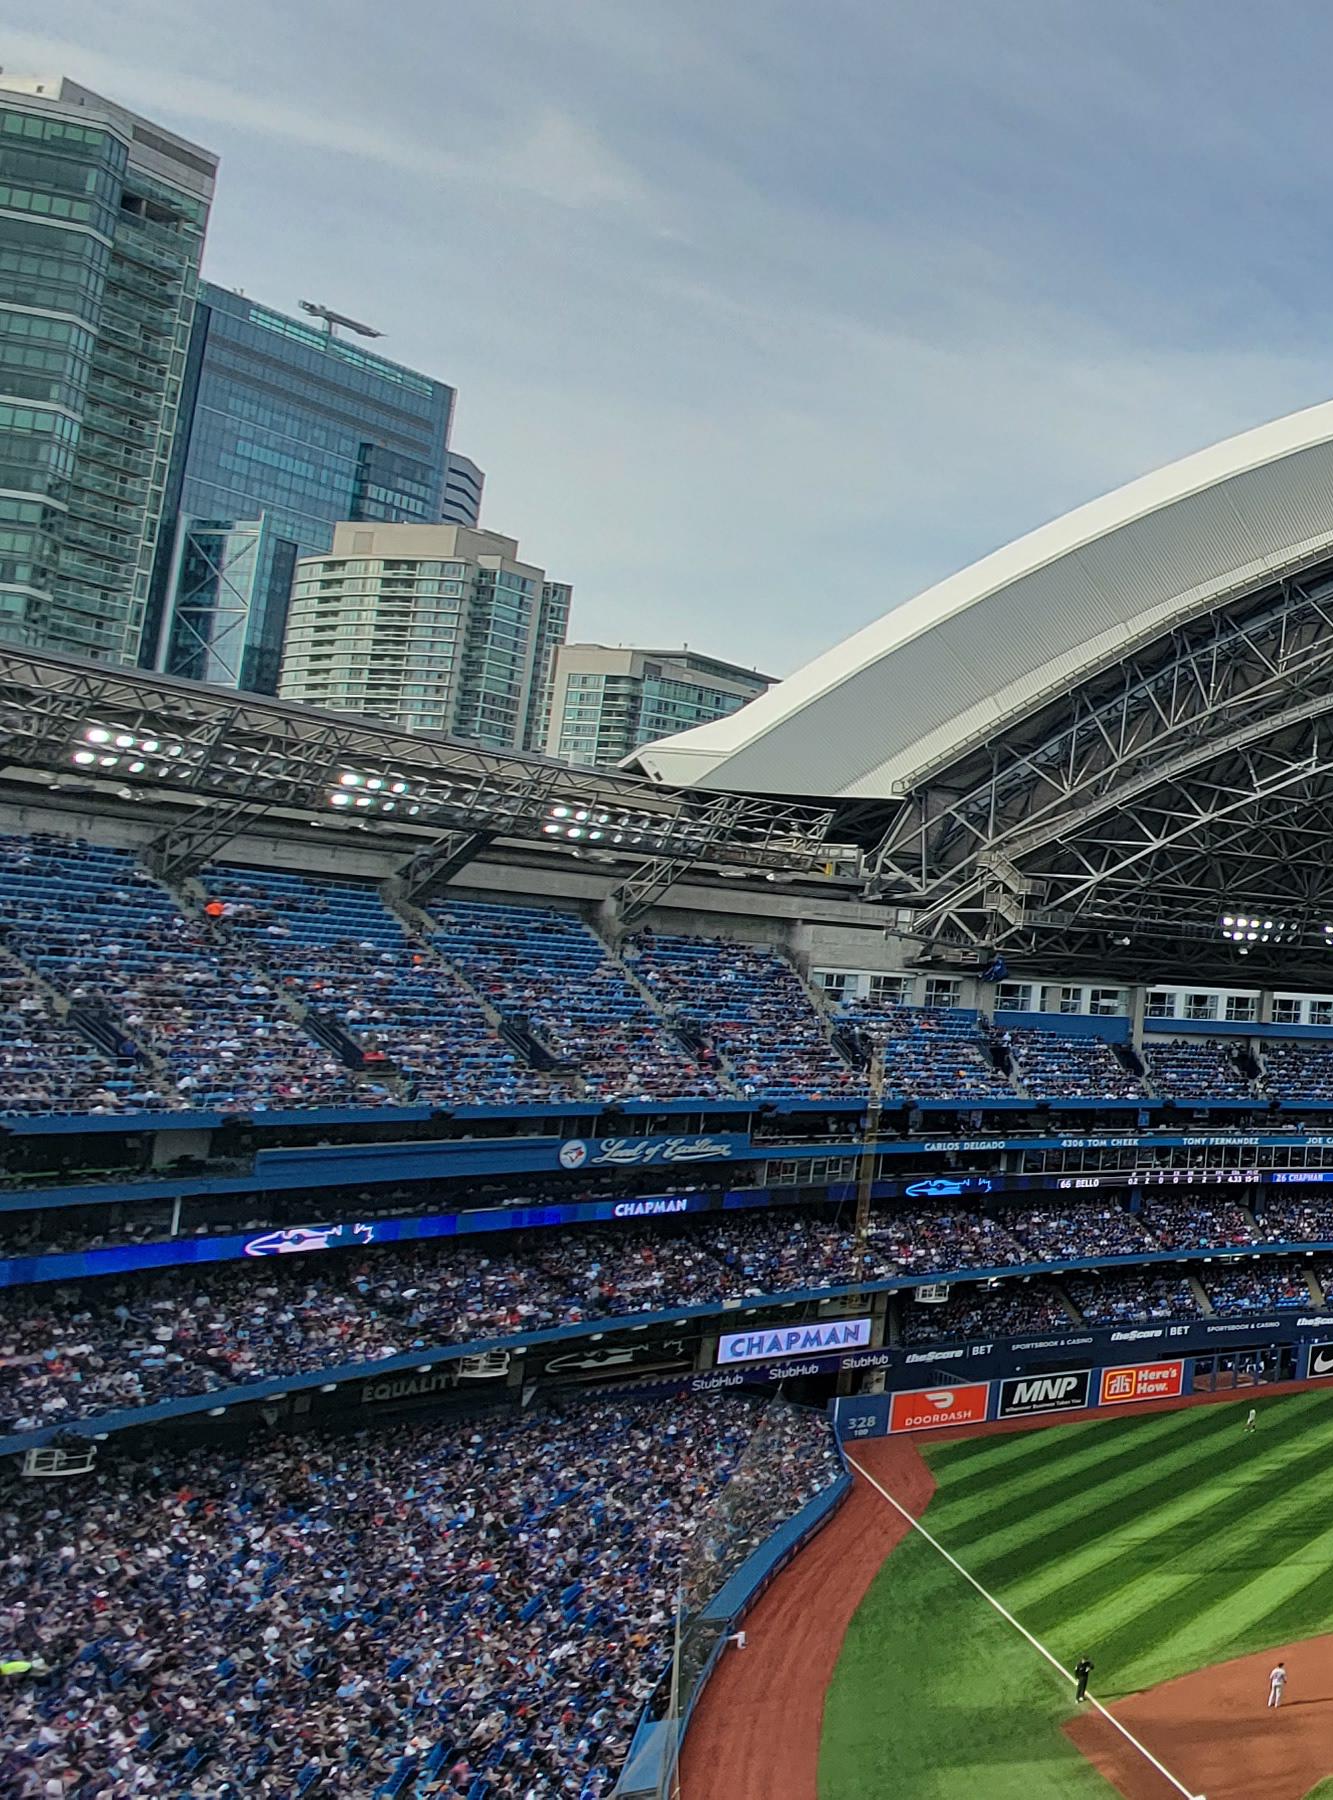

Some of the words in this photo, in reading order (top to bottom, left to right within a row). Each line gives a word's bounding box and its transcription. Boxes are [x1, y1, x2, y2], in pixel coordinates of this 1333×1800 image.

[924, 1142, 960, 1151] CARLOS
[963, 1141, 1006, 1150] DELGADO
[1087, 1139, 1107, 1147] TOM
[1111, 1138, 1139, 1147] CHEEK
[1210, 1137, 1260, 1145] FERNANDEZ
[1075, 1179, 1099, 1188] BELLO
[1276, 1174, 1287, 1182] 26
[1288, 1174, 1323, 1182] CHAPMAN
[615, 1199, 687, 1216] CHAPMAN
[1110, 1329, 1162, 1341] theScore
[1170, 1325, 1190, 1336] BET
[1207, 1323, 1249, 1333] SPORTSBOOK
[1257, 1321, 1280, 1329] CASINO
[730, 1324, 860, 1357] CHAPMAN
[1011, 1340, 1059, 1351] SPORTSBOOK
[1066, 1337, 1093, 1345] CASINO
[905, 1350, 964, 1364] theScore
[972, 1345, 993, 1356] BET
[842, 1355, 888, 1369] StubHub
[768, 1364, 819, 1380] StubHub
[1138, 1368, 1177, 1380] Here's
[362, 1374, 460, 1401] EQUALITY
[692, 1374, 744, 1391] StubHub
[1137, 1381, 1169, 1394] How.
[1012, 1376, 1078, 1405] MNP
[847, 1416, 876, 1430] 328
[905, 1410, 972, 1427] DOORDASH
